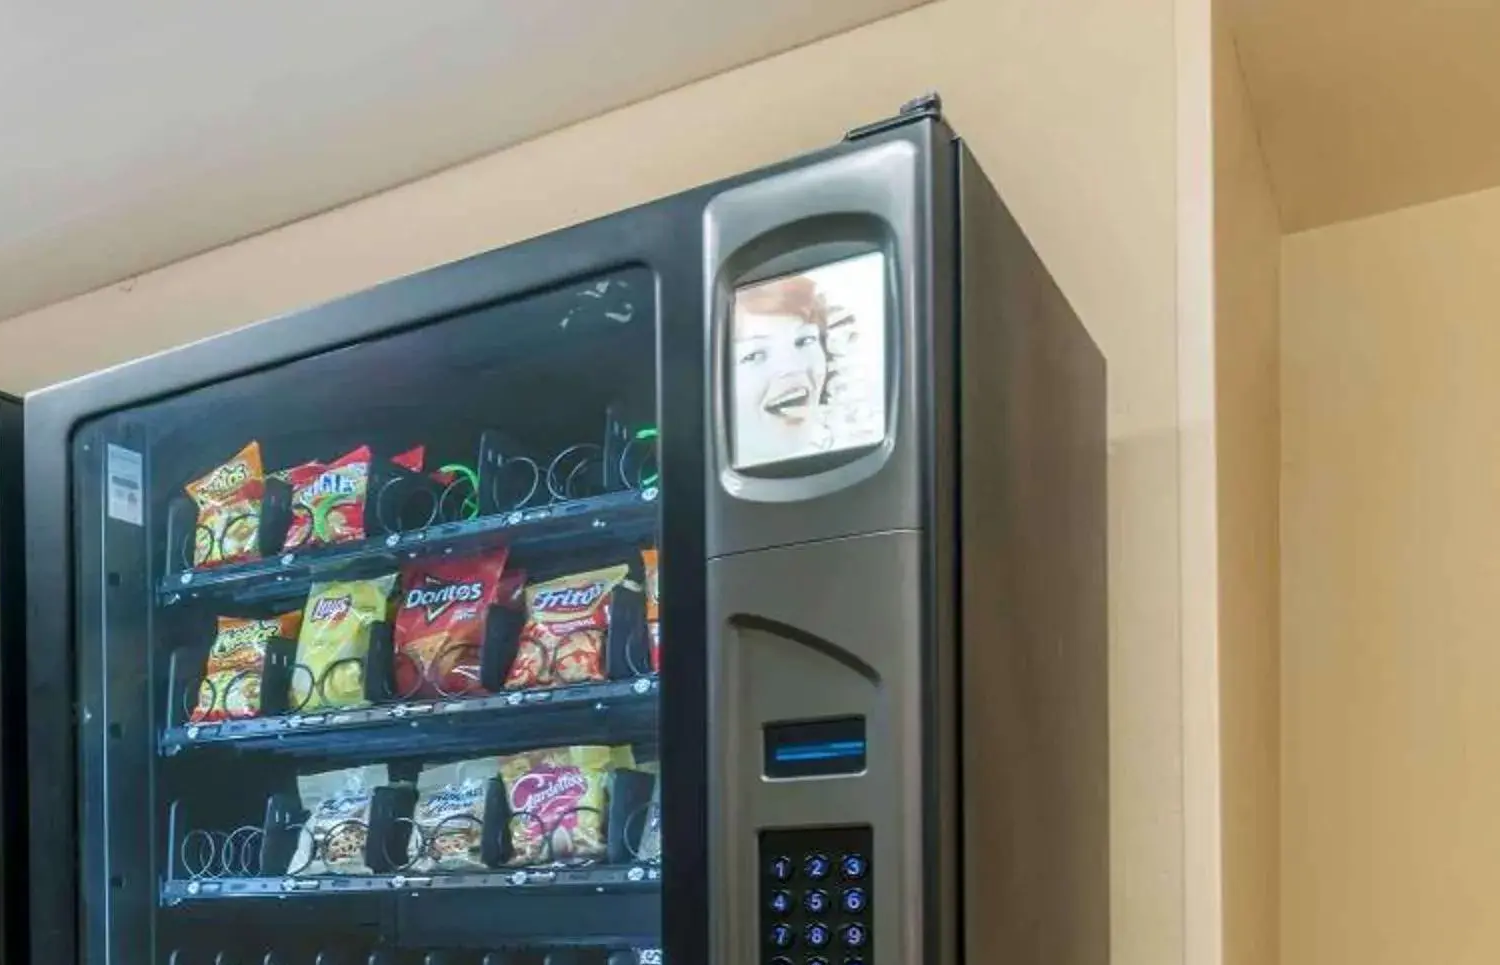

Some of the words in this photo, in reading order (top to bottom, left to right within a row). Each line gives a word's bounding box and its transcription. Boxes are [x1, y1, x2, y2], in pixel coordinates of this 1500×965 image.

[406, 582, 483, 608] Doritos
[775, 861, 784, 878] 1
[811, 859, 822, 876] 2
[847, 858, 859, 875] 3
[774, 894, 786, 911] 4
[811, 893, 822, 911] 5
[847, 892, 860, 909] 6
[775, 927, 786, 945] 7
[811, 927, 822, 944] 8
[848, 927, 861, 945] 9
